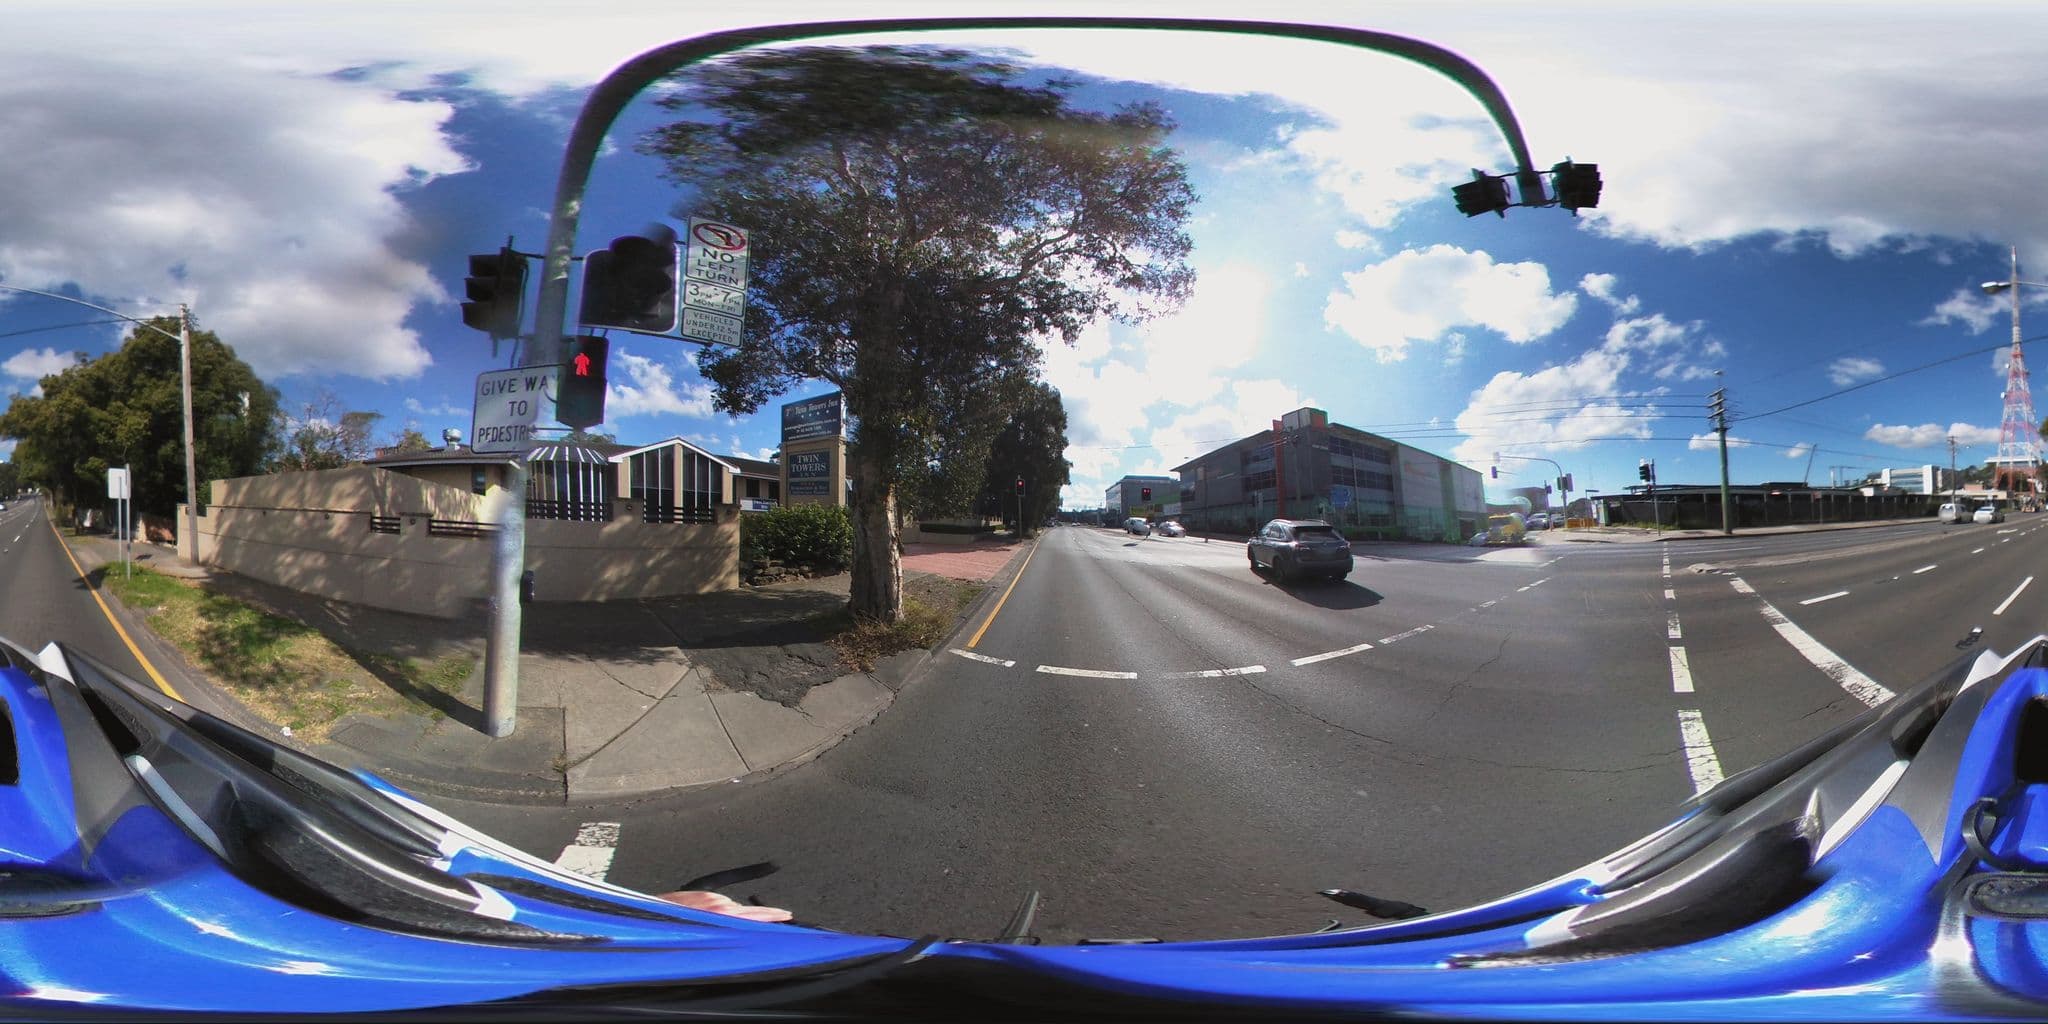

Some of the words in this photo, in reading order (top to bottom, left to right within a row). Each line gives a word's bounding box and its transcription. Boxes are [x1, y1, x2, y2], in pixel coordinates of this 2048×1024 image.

[702, 247, 735, 264] NO
[697, 258, 737, 274] LEFT
[695, 268, 739, 286] TURN
[686, 318, 715, 331] UNDER
[693, 311, 734, 326] VEHICLES
[691, 327, 733, 343] EXCEPTED
[481, 378, 517, 396] GIVE
[525, 375, 555, 391] WA
[509, 401, 527, 417] TO
[797, 454, 820, 464] TWIN
[791, 462, 827, 473] TOWERS
